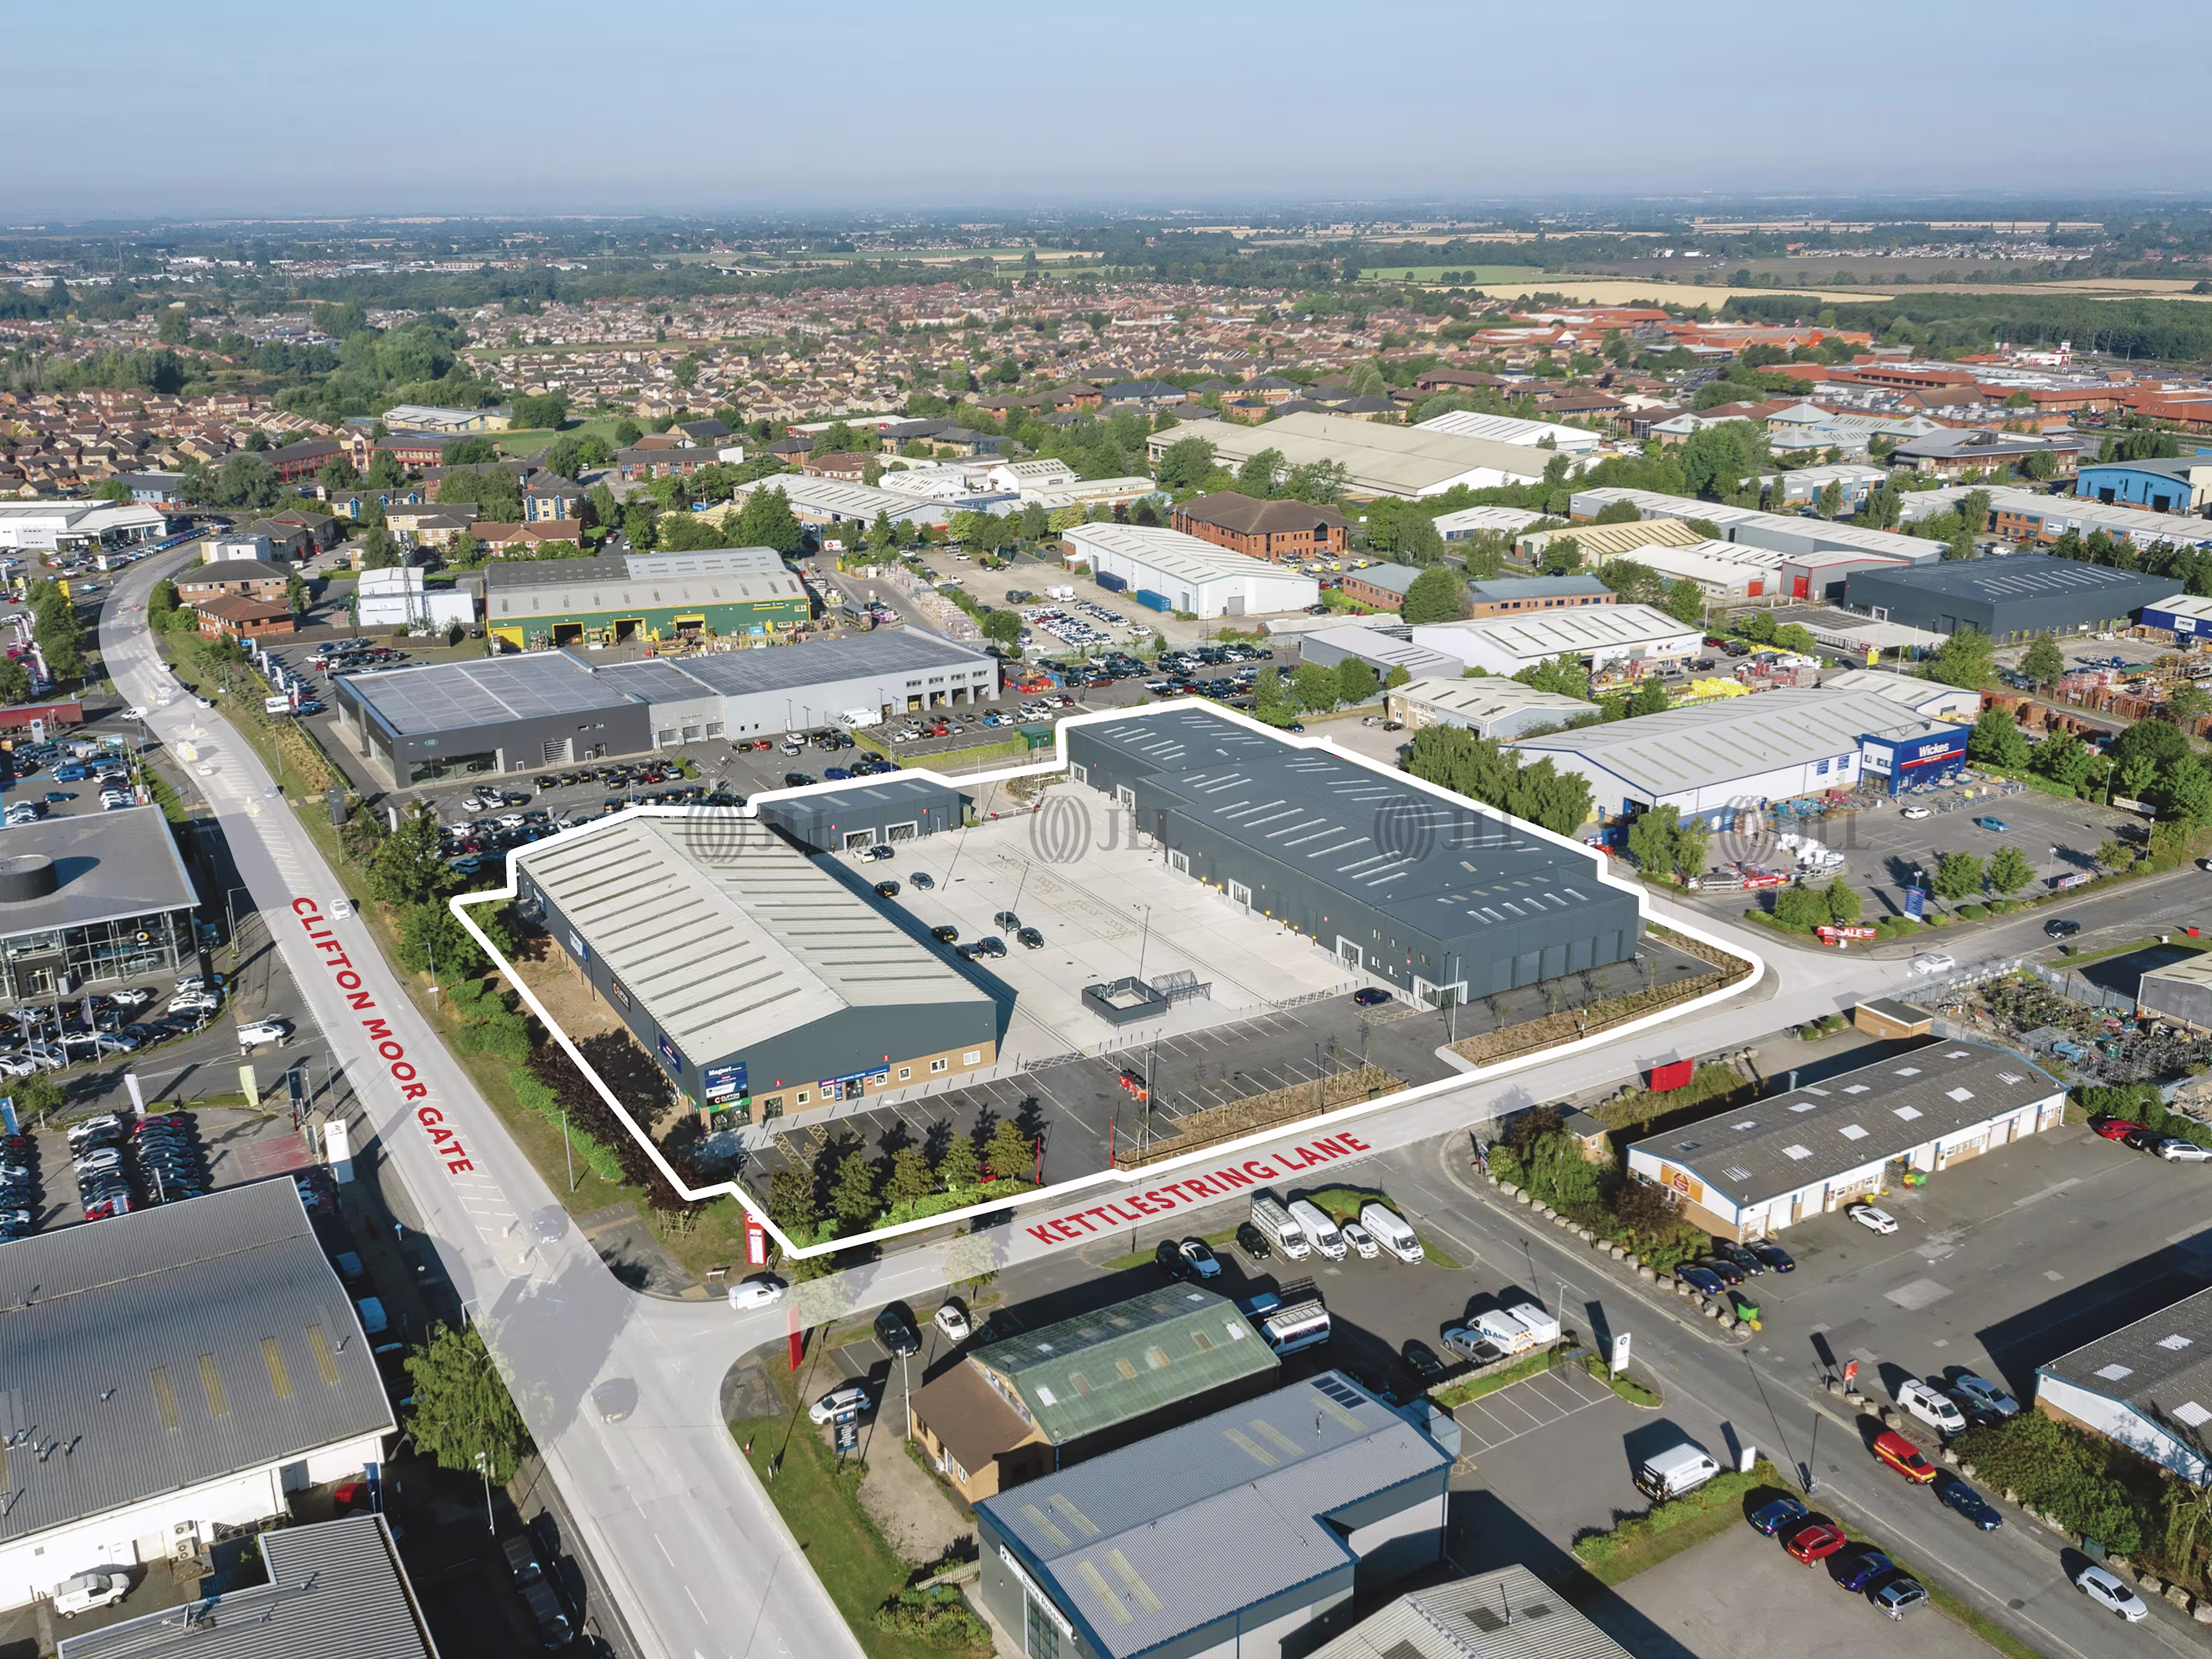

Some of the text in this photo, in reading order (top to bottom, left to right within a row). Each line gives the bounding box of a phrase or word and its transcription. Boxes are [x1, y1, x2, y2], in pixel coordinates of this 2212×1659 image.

[1919, 743, 1950, 757] Wickes
[1836, 929, 1862, 938] SALE
[708, 1066, 732, 1077] Magnet
[1022, 1574, 1065, 1630] Barrie Robson
